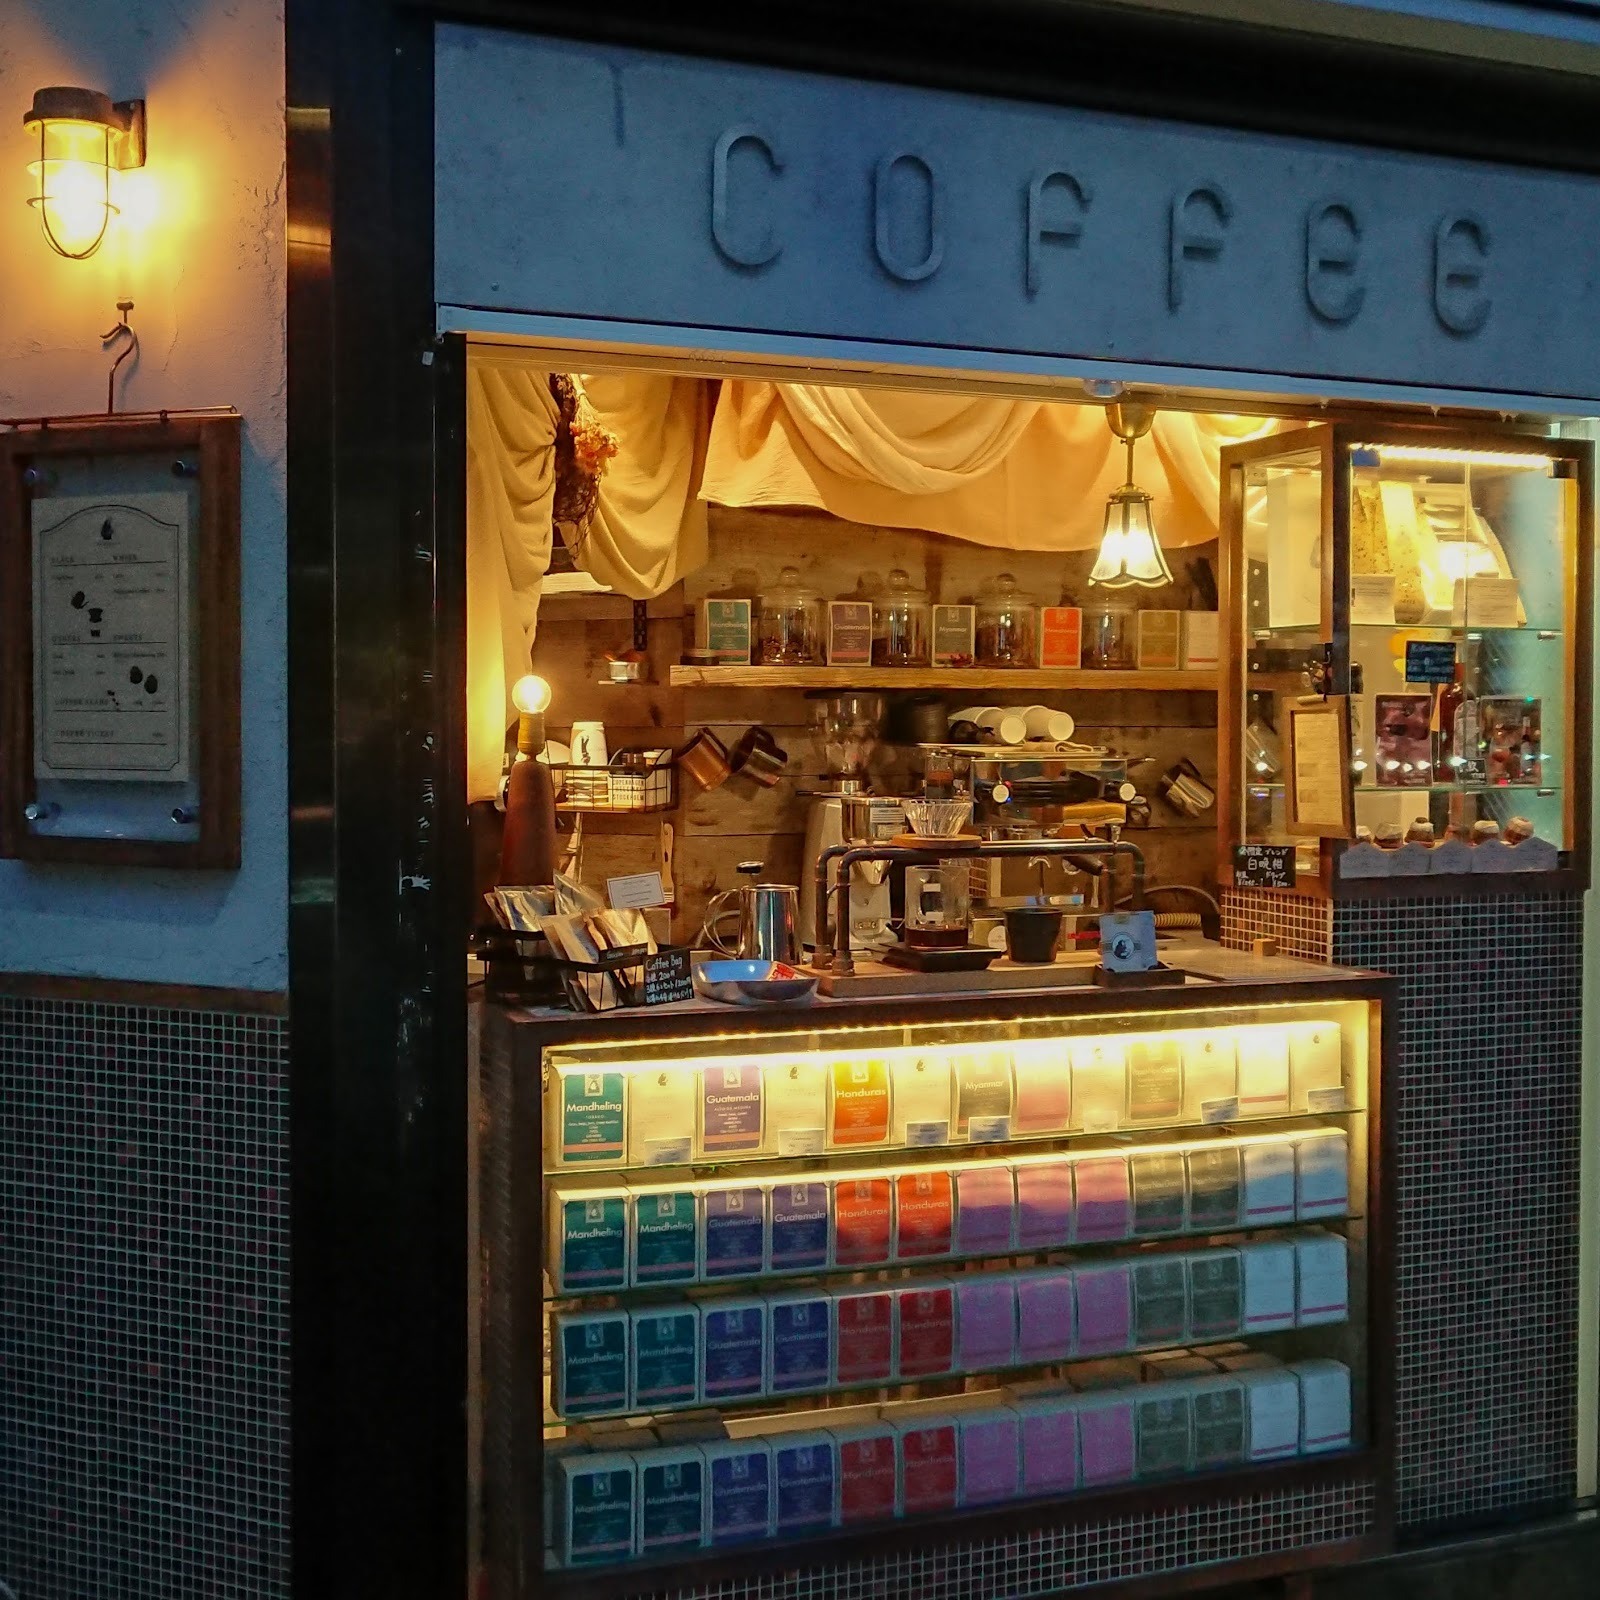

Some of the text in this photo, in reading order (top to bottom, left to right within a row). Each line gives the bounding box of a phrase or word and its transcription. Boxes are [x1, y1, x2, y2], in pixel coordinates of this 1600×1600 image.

[645, 954, 683, 971] Coffee Bag
[965, 1080, 1004, 1091] Myanmar
[706, 1092, 760, 1104] Guatemala
[836, 1088, 887, 1099] Honduras
[566, 1101, 622, 1112] Mandheling
[900, 1200, 949, 1211] Honduras
[775, 1211, 827, 1223] Guatemala
[839, 1208, 888, 1219] Honduras
[640, 1221, 694, 1234] Mandheling
[709, 1216, 761, 1228] Guatemala
[567, 1227, 623, 1240] Mandheling
[640, 1345, 694, 1358] Mandheling
[568, 1352, 623, 1365] Mandheling
[646, 1492, 700, 1505] Mandheling
[575, 1500, 630, 1514] Mandheling
